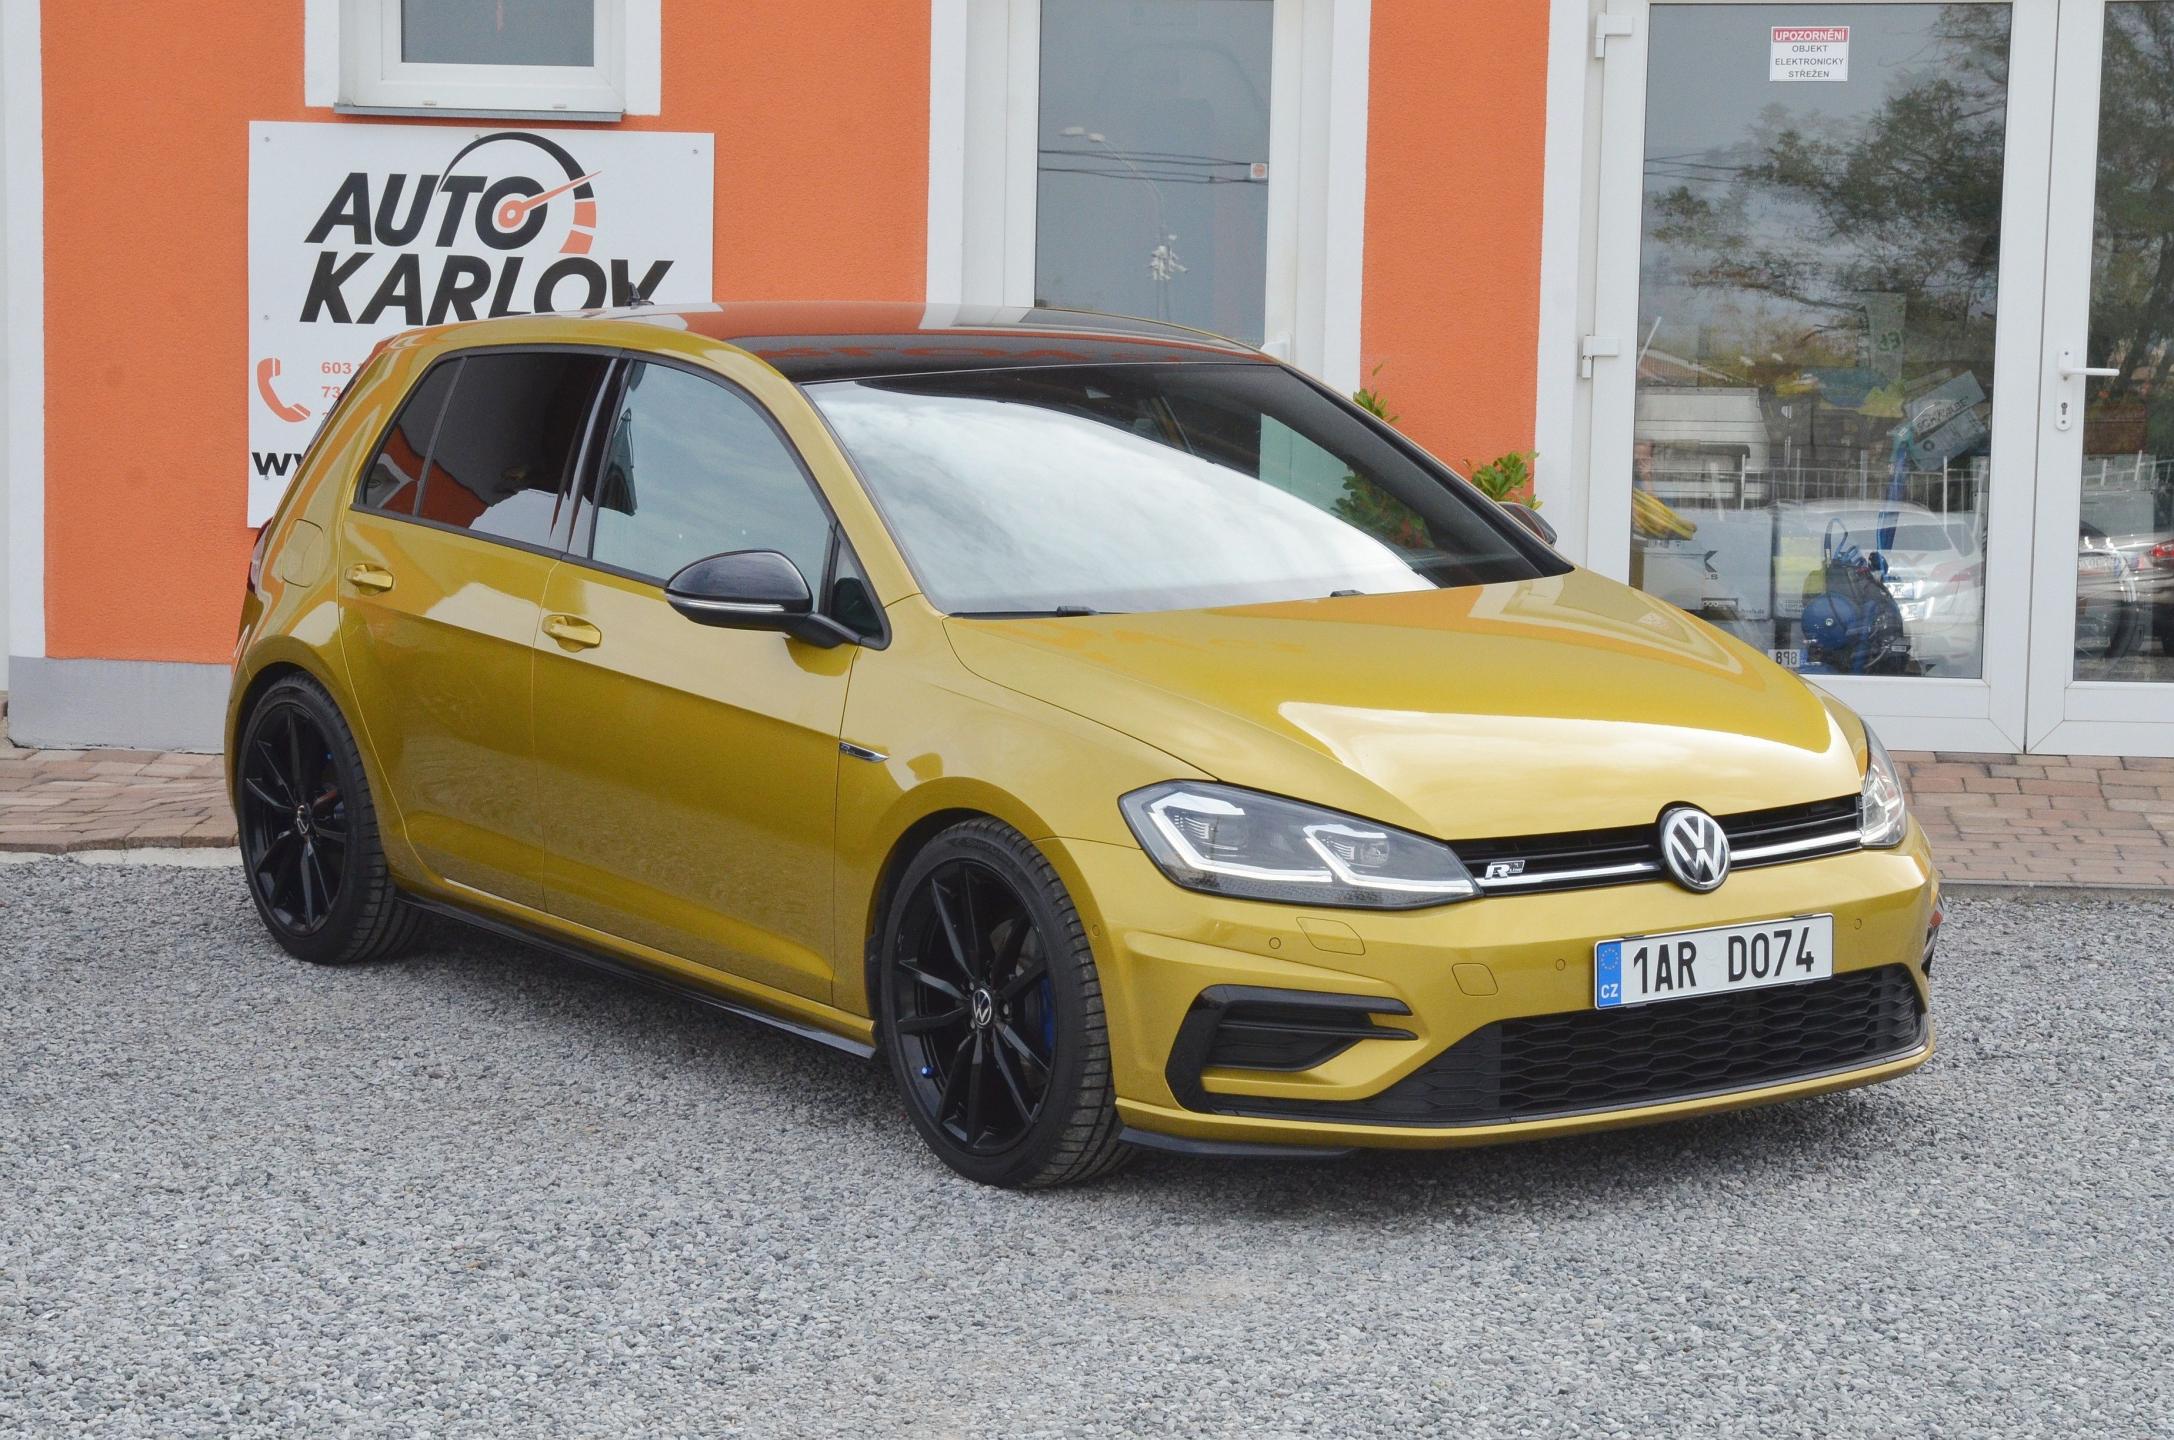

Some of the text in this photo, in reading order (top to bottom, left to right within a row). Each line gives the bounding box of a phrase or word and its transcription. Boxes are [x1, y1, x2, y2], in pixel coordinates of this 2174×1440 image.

[1775, 29, 1845, 41] UPOZORNĚNÍ
[1791, 45, 1828, 53] OBJEKT
[1775, 58, 1844, 66] ELEKTRONICKY
[1788, 70, 1830, 78] STŘEŽEN
[304, 172, 548, 249] AUTO
[299, 251, 675, 326] KARLOV
[321, 362, 352, 374] 603
[1633, 927, 1814, 994] 1AR D074
[1601, 983, 1618, 999] CZ
